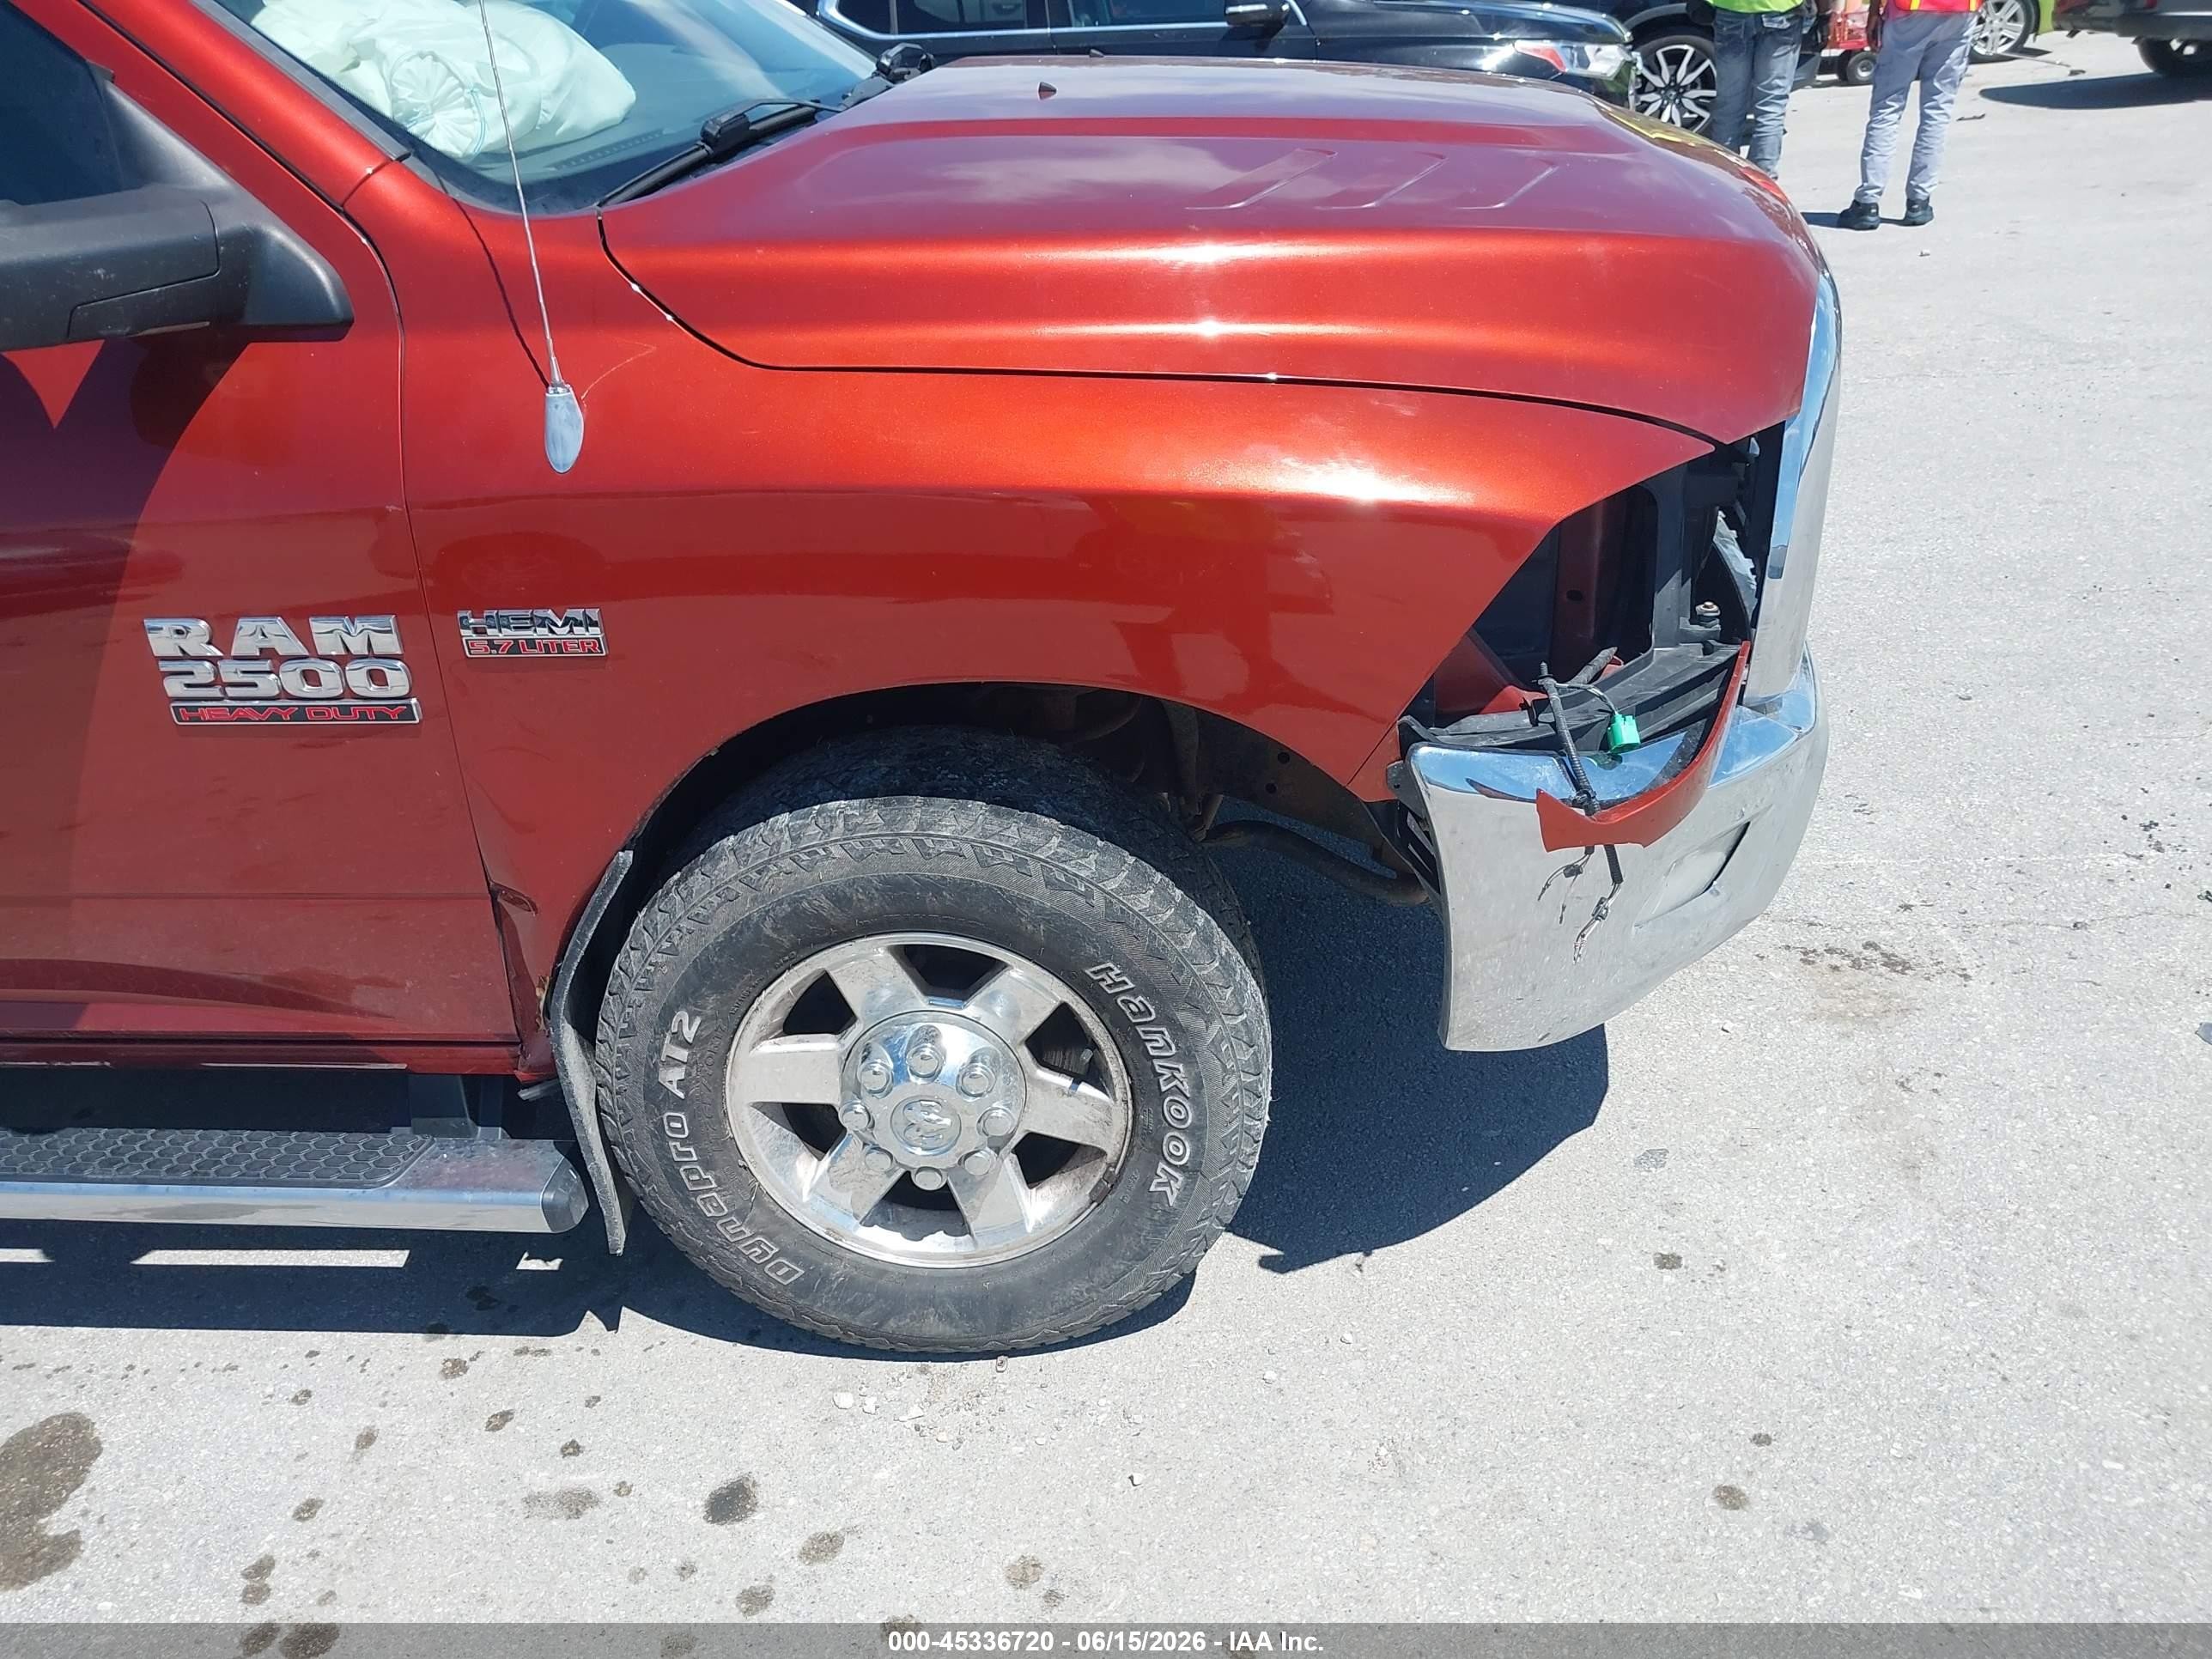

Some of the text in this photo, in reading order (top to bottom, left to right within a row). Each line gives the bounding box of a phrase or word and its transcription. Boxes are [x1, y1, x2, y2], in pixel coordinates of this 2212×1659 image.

[143, 615, 404, 657] RAM
[457, 608, 605, 636] HEMI
[468, 639, 601, 654] 5.7 LITER
[158, 658, 412, 699] 2500
[179, 707, 407, 721] HEAVY DUTY
[659, 1011, 805, 1285] Dynapro AT2
